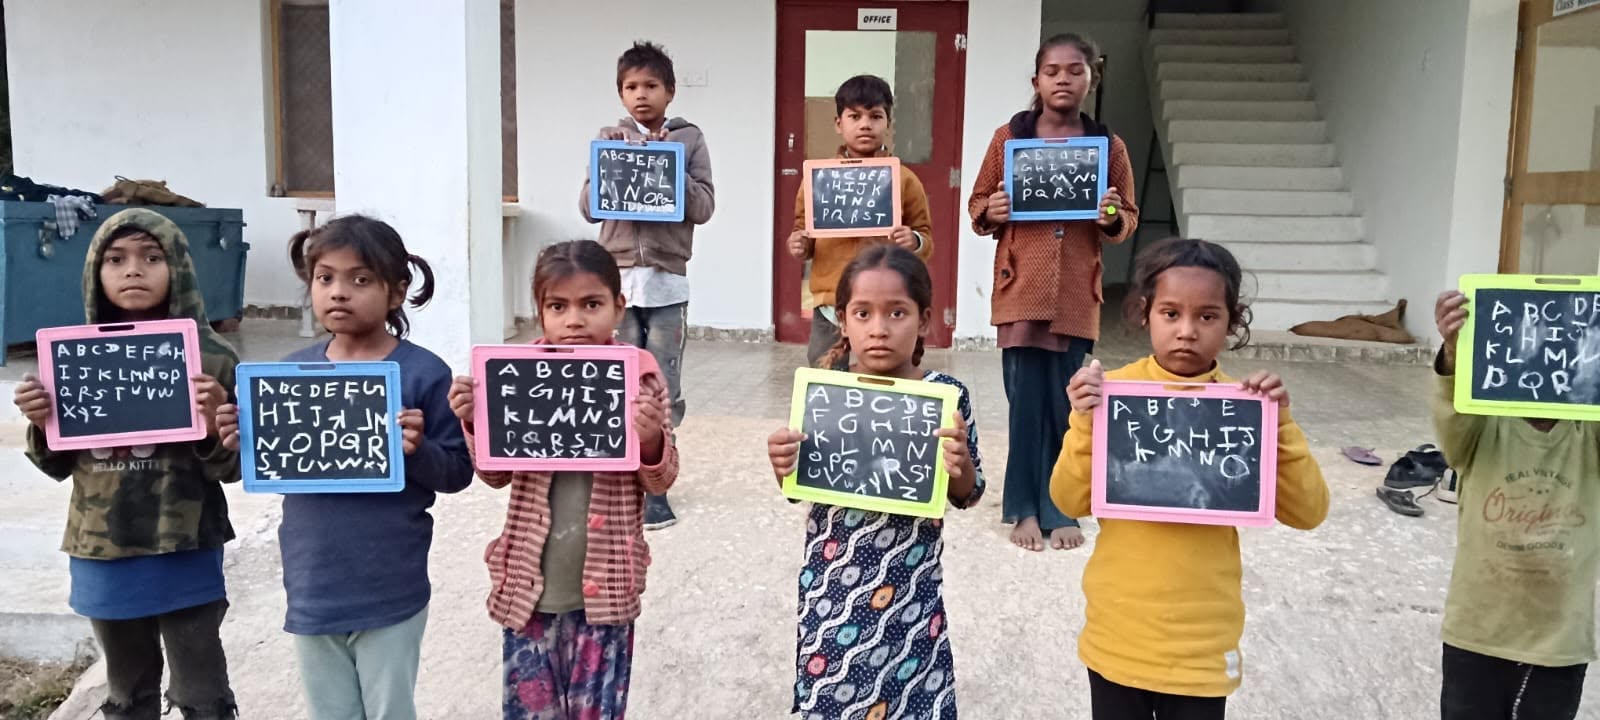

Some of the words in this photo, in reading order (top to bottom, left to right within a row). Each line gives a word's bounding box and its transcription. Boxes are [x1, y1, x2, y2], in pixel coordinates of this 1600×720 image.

[863, 15, 892, 24] OFFICE
[1073, 172, 1089, 183] N
[624, 185, 640, 200] N
[857, 183, 867, 195] J
[1023, 189, 1032, 201] P
[1053, 188, 1065, 199] R
[1082, 189, 1092, 200] T
[821, 194, 829, 203] L
[835, 195, 846, 205] M
[852, 197, 863, 205] N
[823, 208, 829, 221] P
[875, 213, 886, 224] T
[1492, 300, 1512, 320] A
[1575, 298, 1587, 315] D
[1545, 327, 1564, 341] I
[58, 344, 70, 357] A
[77, 344, 86, 356] B
[126, 345, 136, 358] E
[143, 346, 154, 360] F
[174, 347, 185, 362] H
[1486, 340, 1500, 359] K
[1506, 347, 1524, 363] L
[1545, 347, 1566, 368] M
[59, 365, 70, 380] I
[79, 367, 91, 379] J
[99, 369, 112, 381] K
[119, 368, 128, 380] L
[144, 366, 153, 381] N
[499, 363, 519, 376] A
[536, 361, 552, 378] B
[561, 364, 575, 378] C
[582, 362, 597, 378] D
[606, 365, 623, 379] E
[115, 387, 125, 401] T
[259, 379, 274, 397] A
[310, 385, 320, 397] D
[325, 382, 339, 397] E
[1518, 372, 1543, 400] Q
[1552, 370, 1572, 395] R
[501, 385, 516, 397] F
[529, 383, 553, 400] G
[562, 388, 574, 406] H
[580, 386, 596, 403] I
[605, 389, 624, 411] J
[809, 386, 829, 404] A
[844, 389, 864, 408] B
[870, 396, 895, 413] C
[923, 402, 938, 418] E
[259, 403, 278, 426] H
[283, 402, 302, 424] I
[310, 406, 322, 427] J
[528, 409, 544, 424] L
[548, 407, 575, 427] M
[582, 407, 602, 424] N
[1114, 400, 1132, 420] A
[1148, 399, 1158, 415] B
[1222, 400, 1235, 416] E
[812, 409, 831, 423] F
[901, 416, 917, 435] I
[921, 420, 937, 436] J
[257, 437, 280, 450] N
[321, 430, 337, 457] P
[368, 436, 386, 460] R
[551, 433, 563, 448] R
[590, 434, 605, 450] T
[814, 430, 830, 448] K
[841, 438, 859, 455] L
[872, 437, 895, 456] M
[907, 441, 927, 461] N
[1128, 421, 1141, 438] F
[1153, 424, 1175, 443] G
[1190, 427, 1209, 447] H
[1217, 427, 1238, 452] I
[278, 453, 293, 467] T
[1168, 438, 1192, 458] M
[1200, 449, 1215, 465] N
